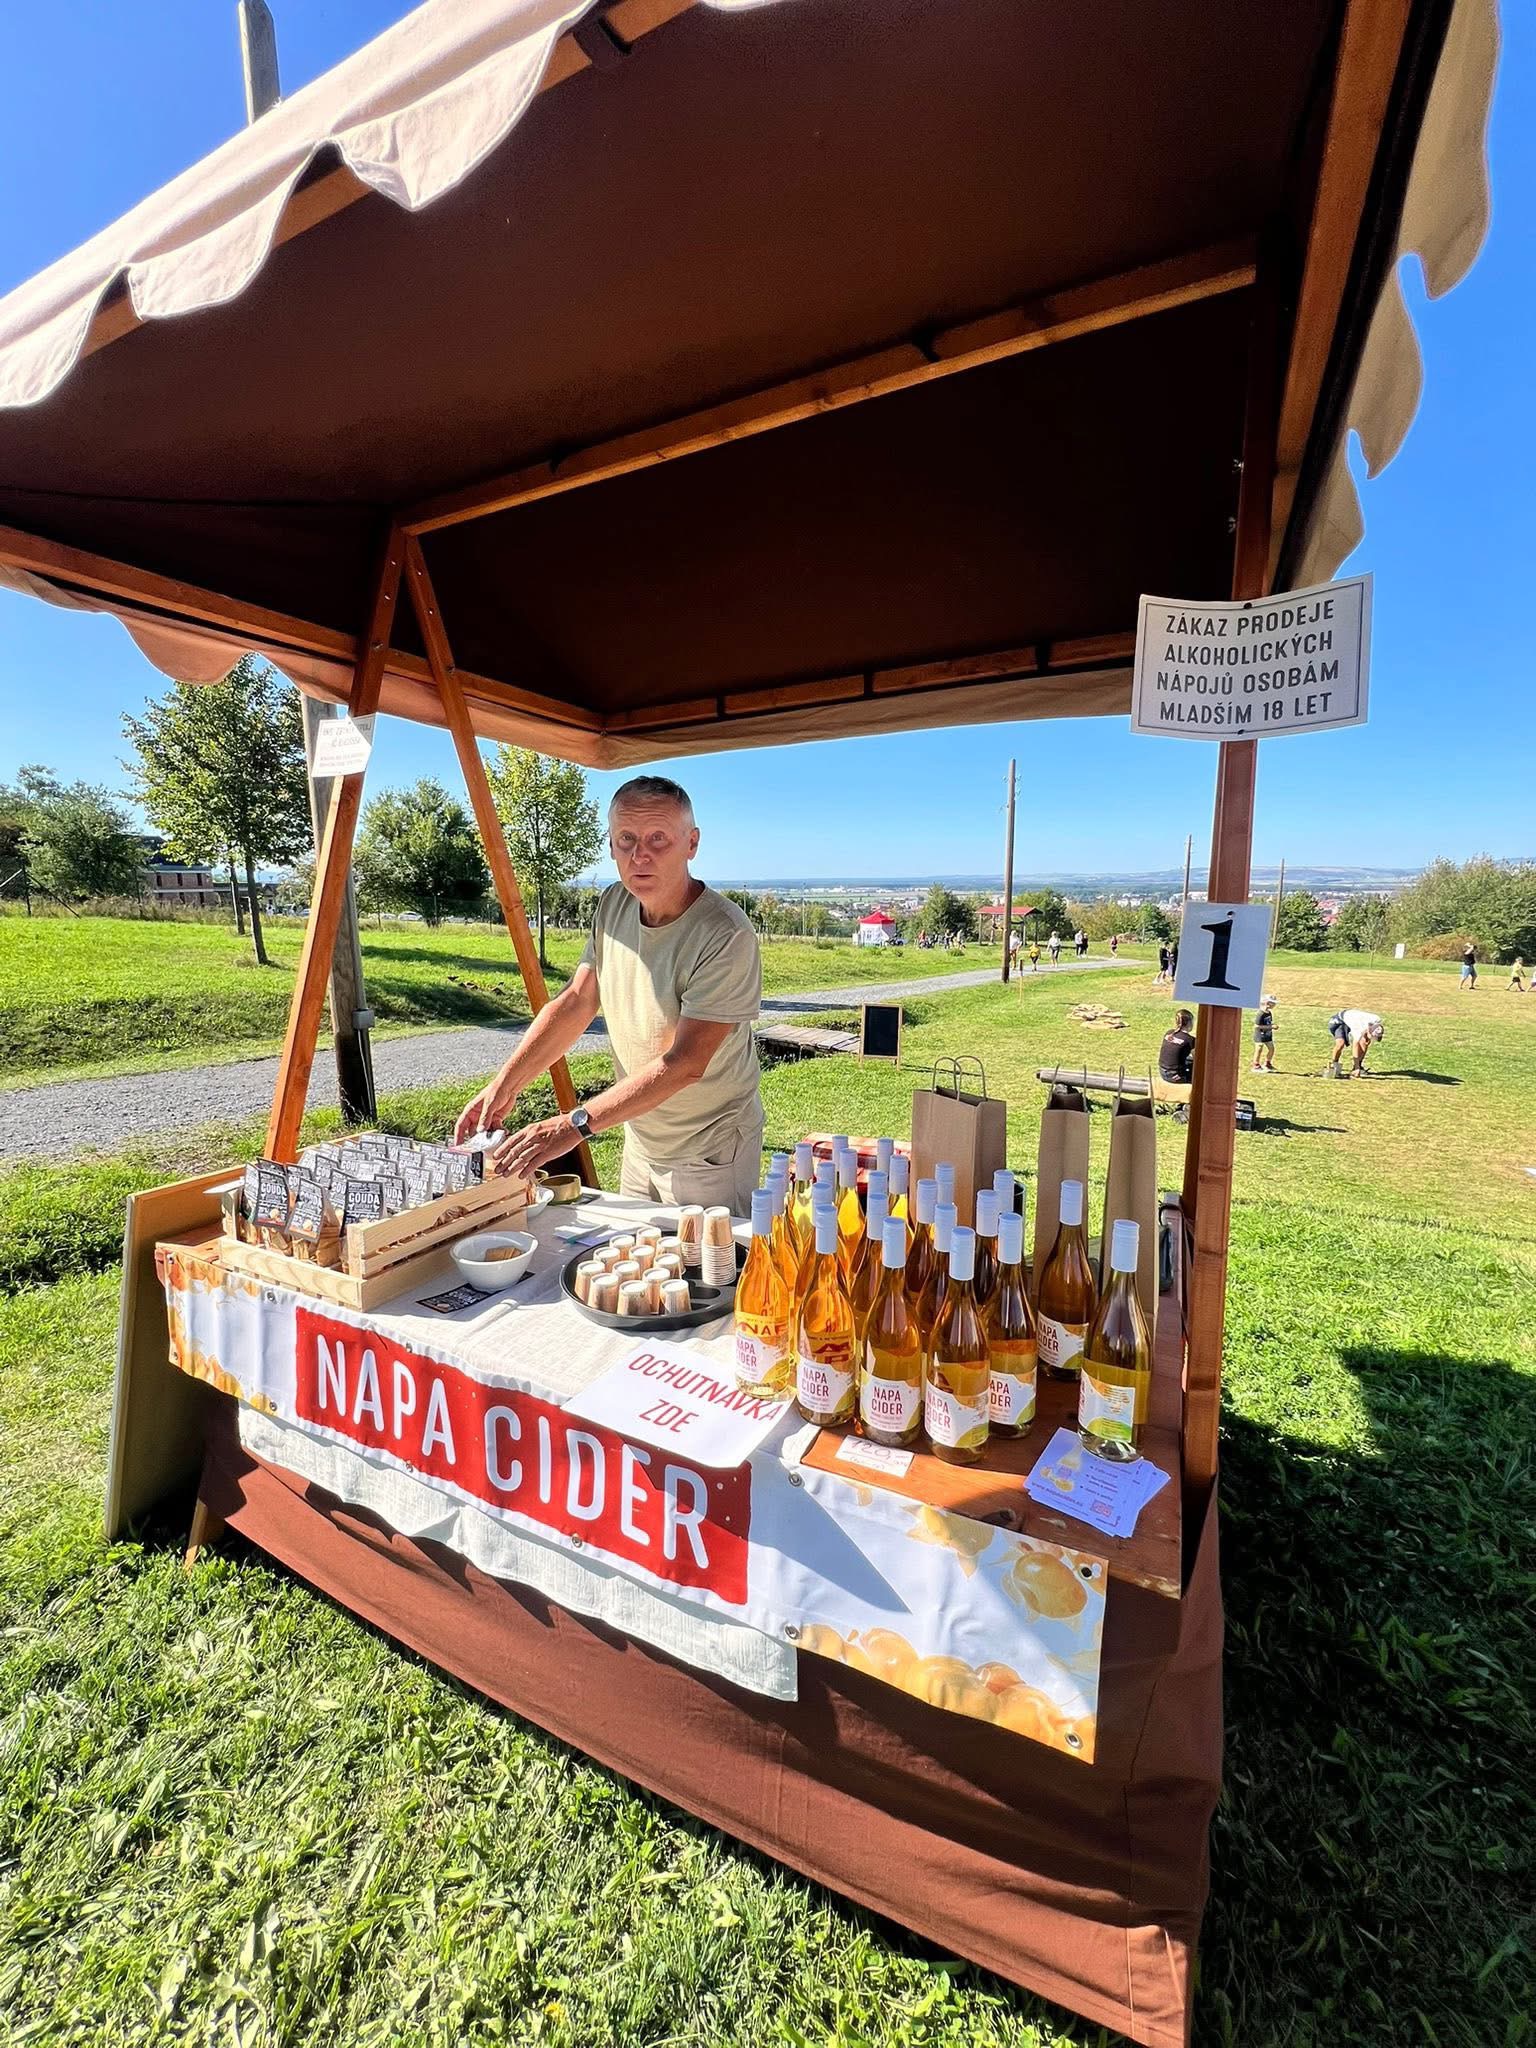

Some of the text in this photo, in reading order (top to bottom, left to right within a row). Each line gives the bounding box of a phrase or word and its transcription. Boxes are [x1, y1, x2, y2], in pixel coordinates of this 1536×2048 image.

[1166, 599, 1335, 637] ZÁKAZ PRODEJE
[1164, 630, 1333, 666] ALKOHOLICKÝCH
[1157, 659, 1340, 696] NÁPOJŮ OSOBÁM
[1160, 691, 1333, 725] MLADŠÍM 18 LET
[261, 1182, 288, 1198] GOUDA
[348, 1191, 380, 1206] GOUDA
[628, 1352, 783, 1421] OCHUTNAVKA
[803, 1366, 828, 1385] NAPA
[801, 1377, 830, 1398] CIDER
[873, 1385, 901, 1402] NAPA
[989, 1379, 1010, 1395] APA
[871, 1398, 903, 1415] CIDER
[927, 1390, 950, 1414] NAPA
[990, 1392, 1012, 1408] DER
[638, 1398, 700, 1433] ZDE
[316, 1333, 710, 1570] NAPA CIDER
